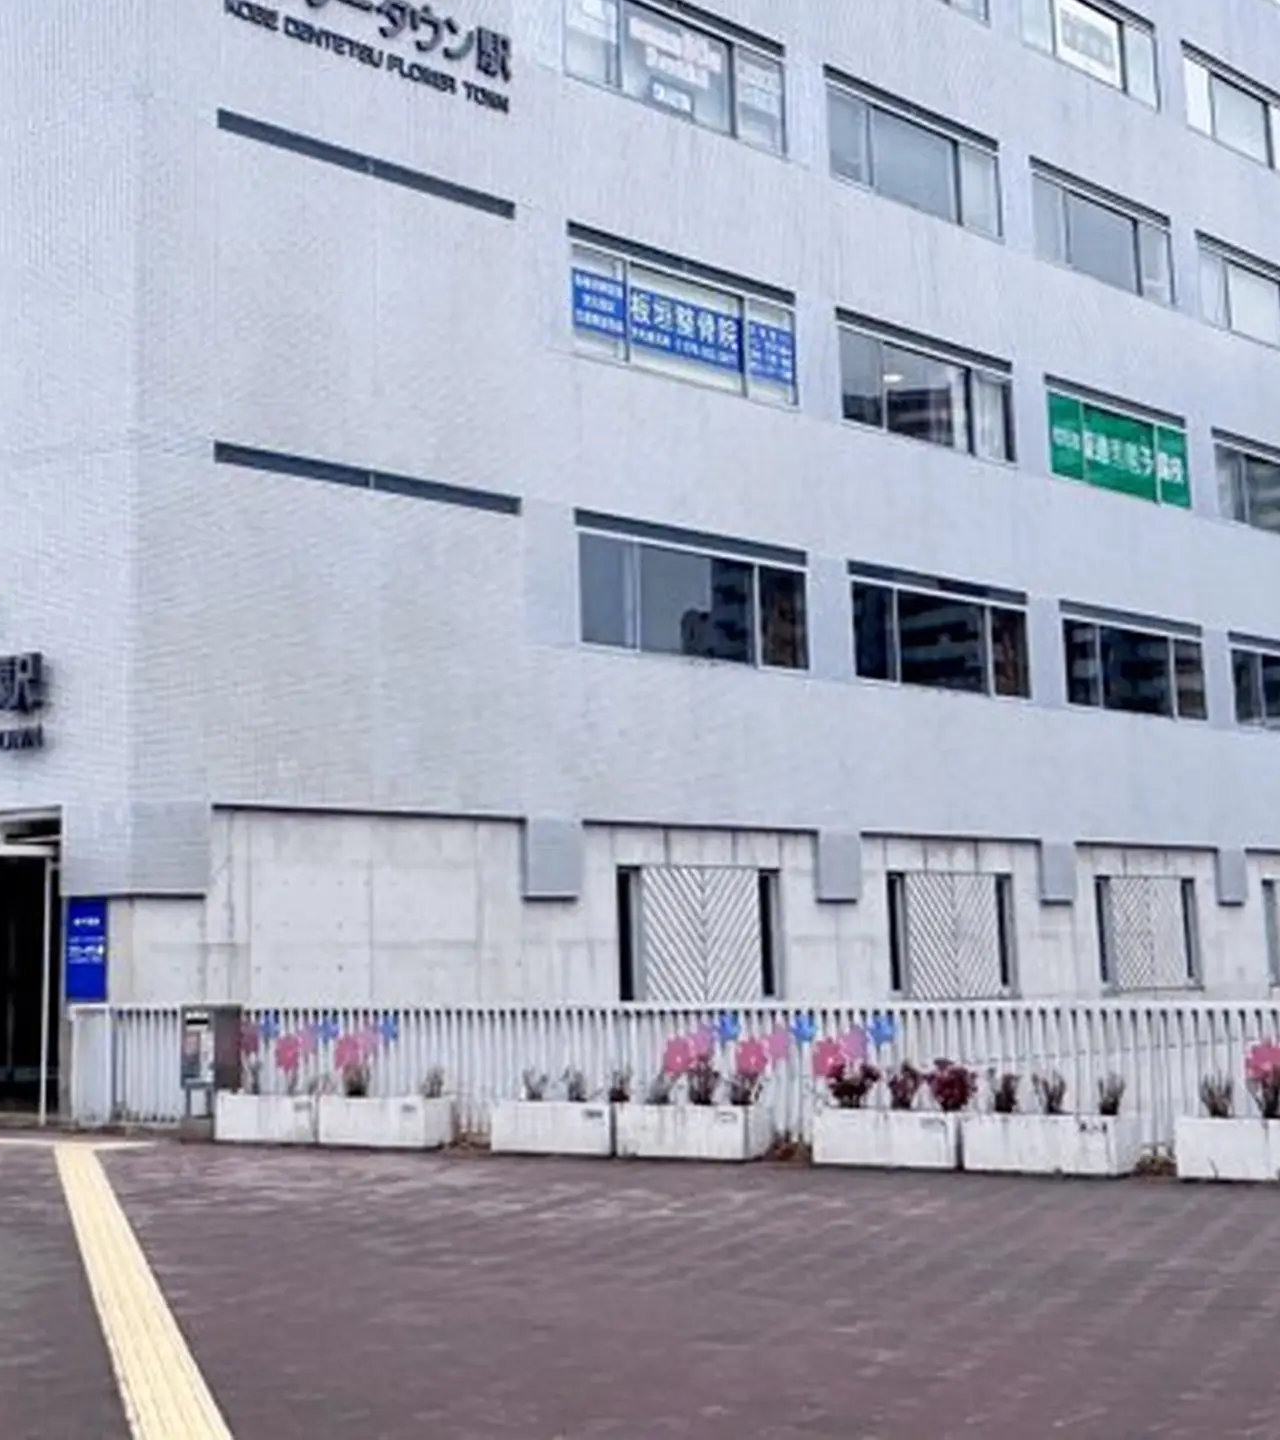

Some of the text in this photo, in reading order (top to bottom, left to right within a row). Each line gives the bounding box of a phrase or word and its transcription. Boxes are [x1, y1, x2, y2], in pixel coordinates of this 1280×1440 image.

[282, 15, 384, 69] DENTETSU
[386, 53, 457, 95] FLOWER
[462, 80, 510, 114] TOWN
